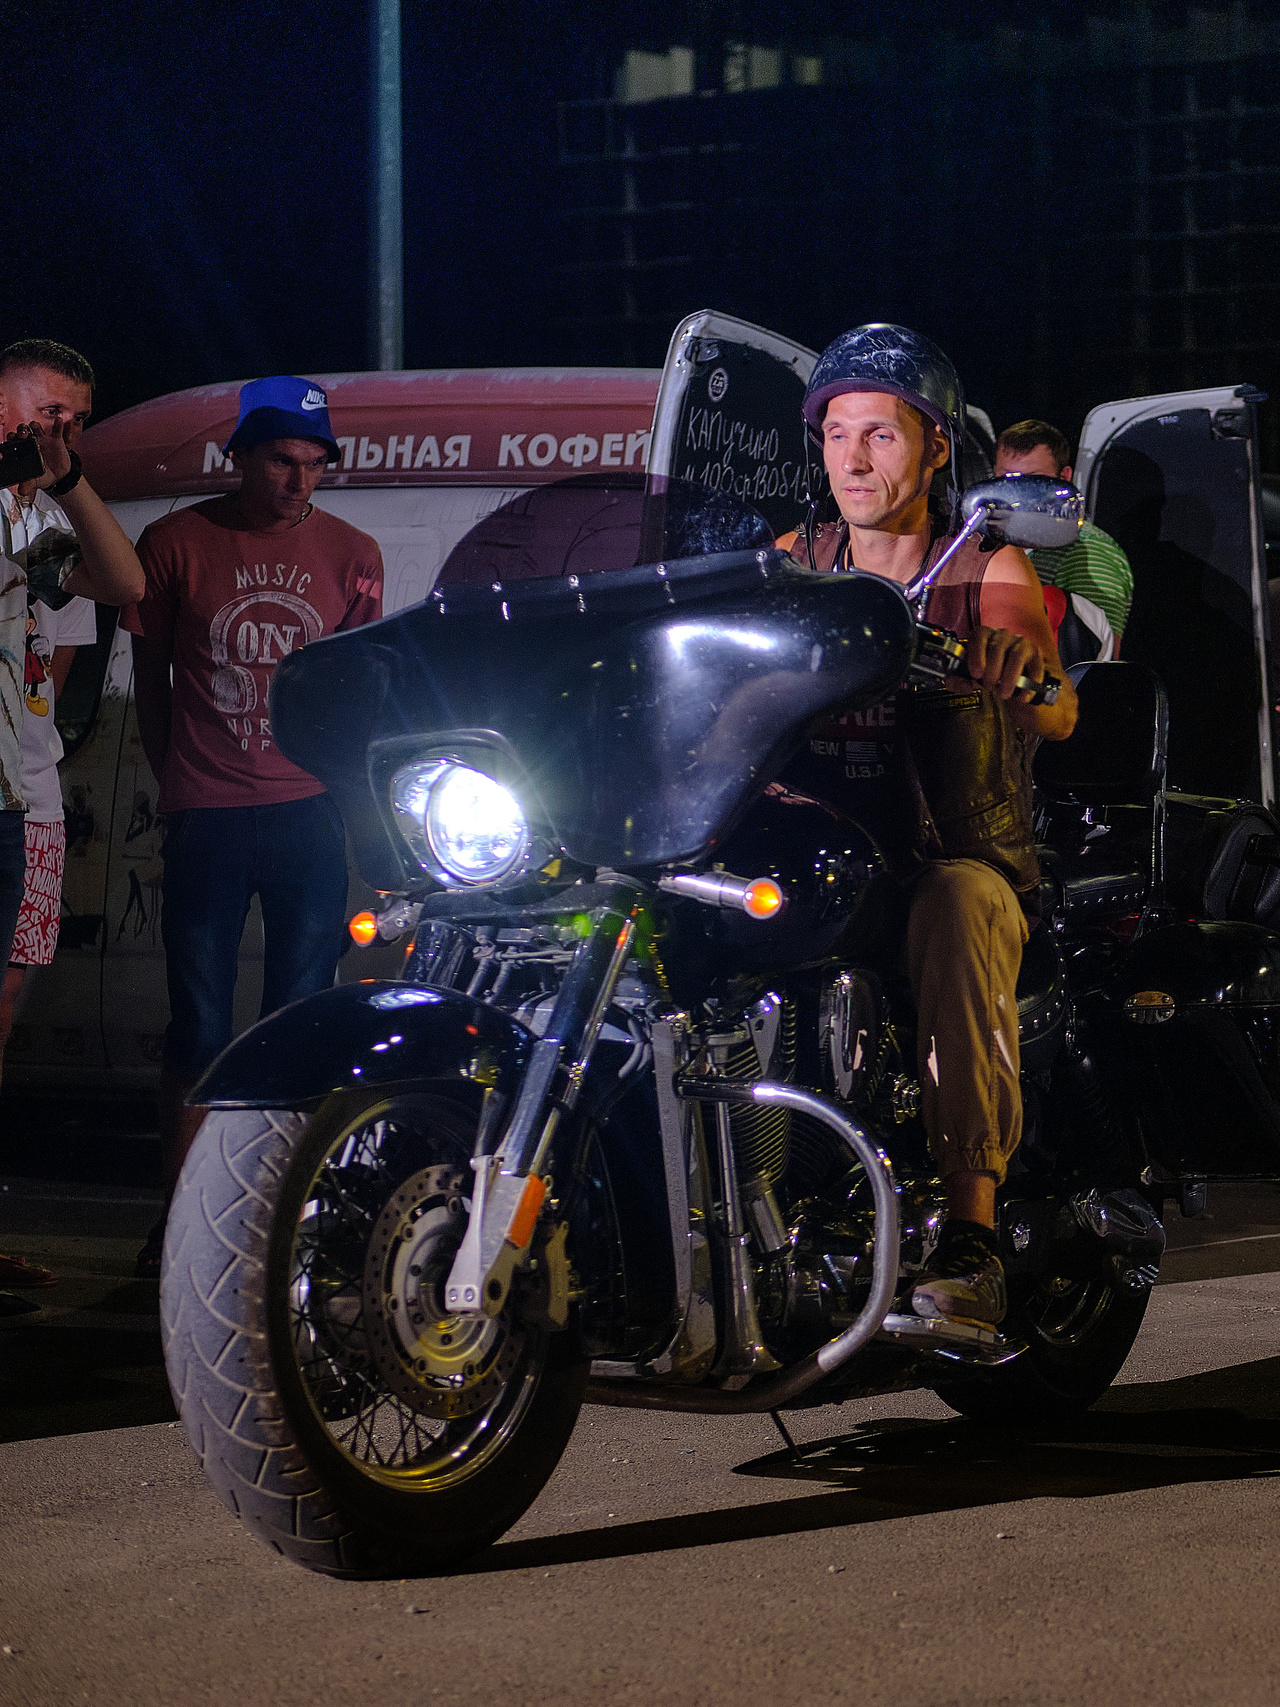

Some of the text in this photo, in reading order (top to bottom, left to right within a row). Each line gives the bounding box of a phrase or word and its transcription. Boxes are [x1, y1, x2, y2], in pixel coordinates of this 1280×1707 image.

[306, 388, 326, 404] NIKE
[202, 429, 652, 474] МЛЬНАЯ КОФЕЙ
[235, 563, 312, 595] MUSIC
[236, 620, 301, 665] ON
